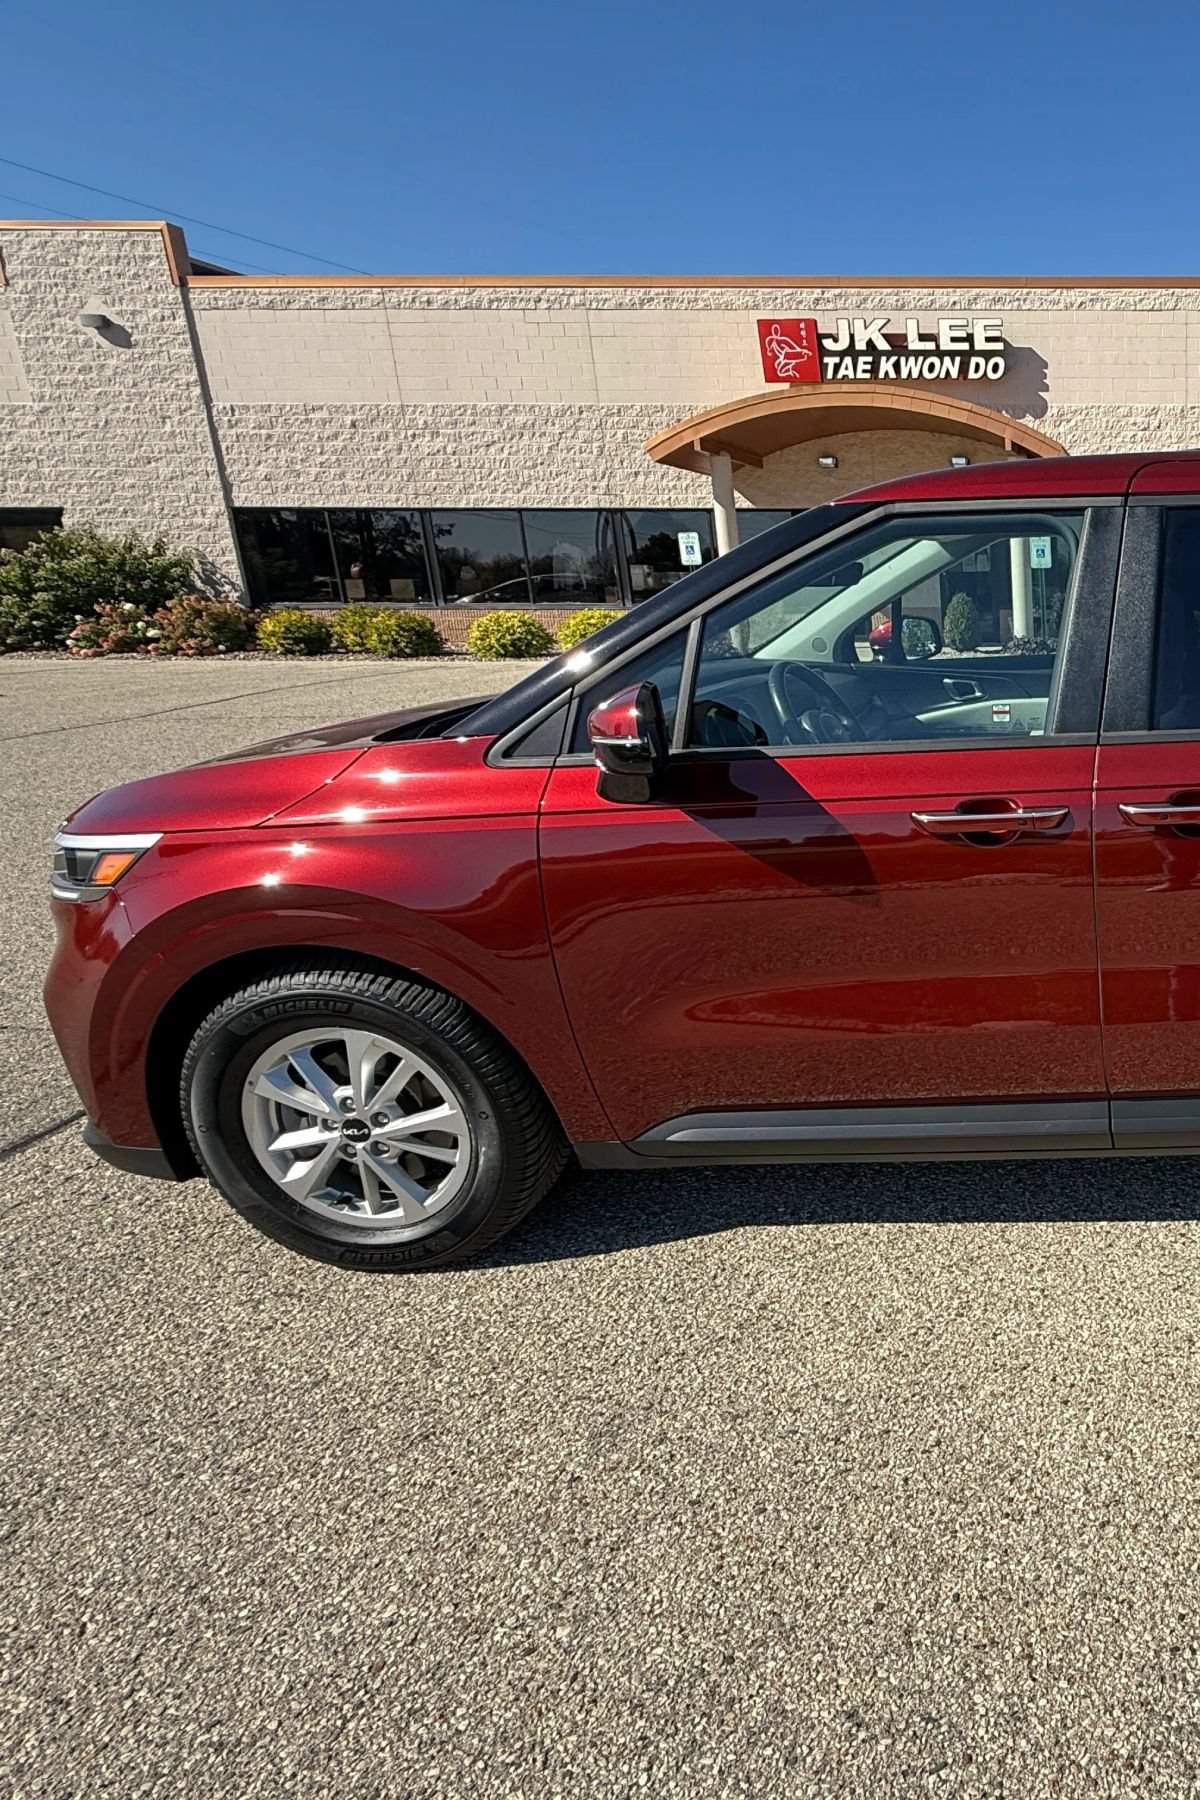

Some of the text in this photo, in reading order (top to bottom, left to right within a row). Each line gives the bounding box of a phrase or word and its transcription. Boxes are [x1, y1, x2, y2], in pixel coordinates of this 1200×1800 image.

[821, 317, 892, 351] JK
[904, 317, 1005, 351] LEE
[822, 356, 1006, 380] TAE KWON DO
[263, 1000, 350, 1017] MICHELIN
